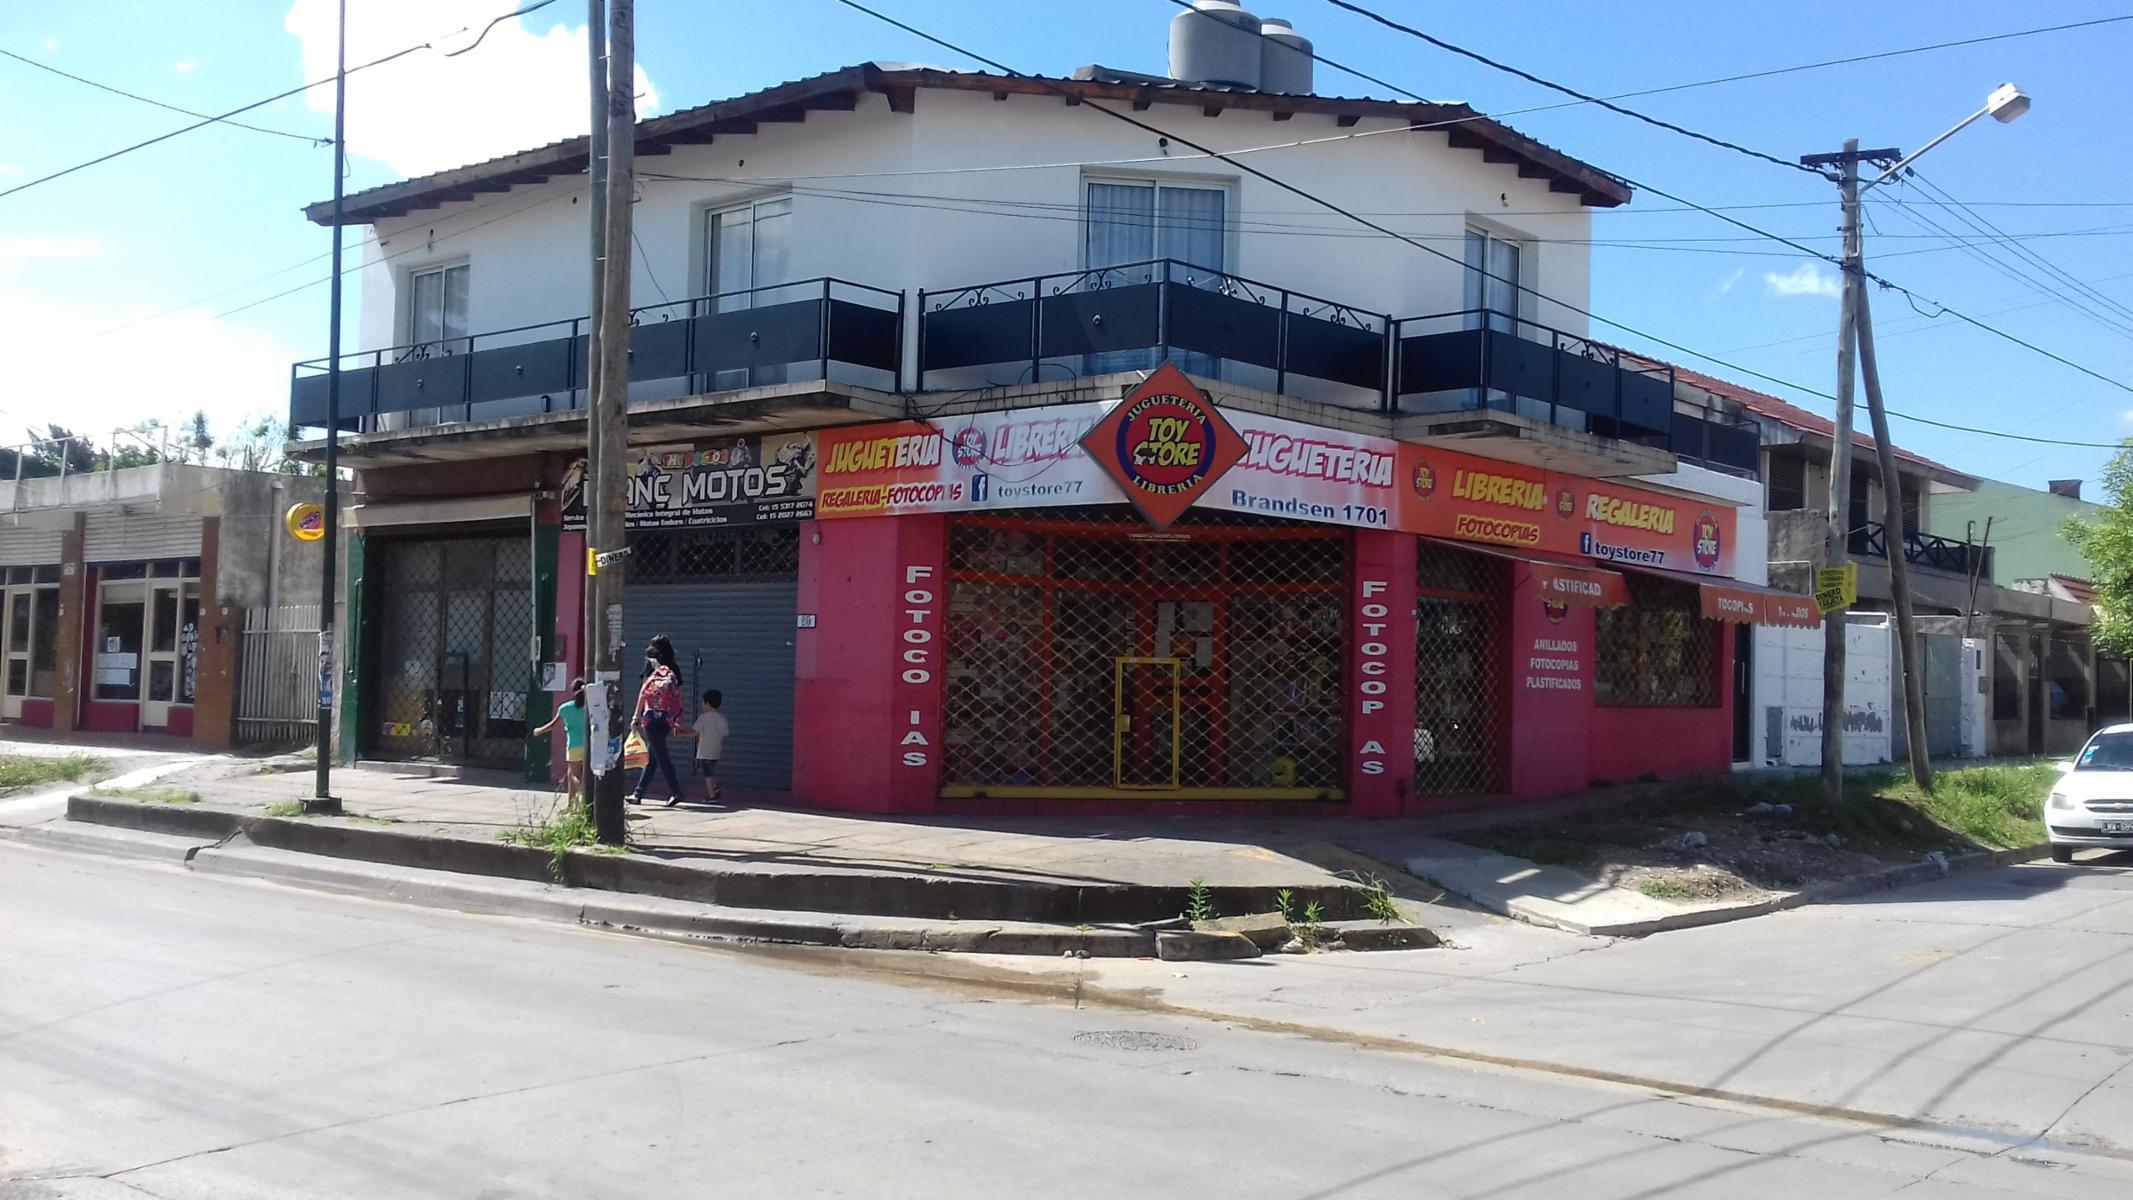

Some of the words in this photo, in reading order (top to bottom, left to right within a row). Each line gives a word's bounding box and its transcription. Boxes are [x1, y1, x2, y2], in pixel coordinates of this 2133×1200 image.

[1127, 395, 1207, 424] JUGUETERIA
[991, 418, 1092, 464] LIBRERI
[1149, 417, 1191, 442] TOY
[825, 433, 942, 474] JUGUETERIA
[1132, 440, 1201, 466] STORE
[683, 465, 788, 504] MOTOS
[998, 481, 1083, 498] toystore77
[1133, 474, 1204, 494] LIBRERIA
[1453, 469, 1545, 510] LIBRERIA
[1231, 488, 1335, 519] Brandsen
[1342, 504, 1388, 525] 1701
[1585, 494, 1675, 534] REGALERIA
[1457, 516, 1538, 542] FOTOCOPIAS
[1595, 541, 1665, 564] toystore77
[1534, 639, 1577, 652] ANILLADOS
[1530, 657, 1579, 671] FOTOCOPIAS
[1526, 676, 1582, 690] PLASTIFICADOS
